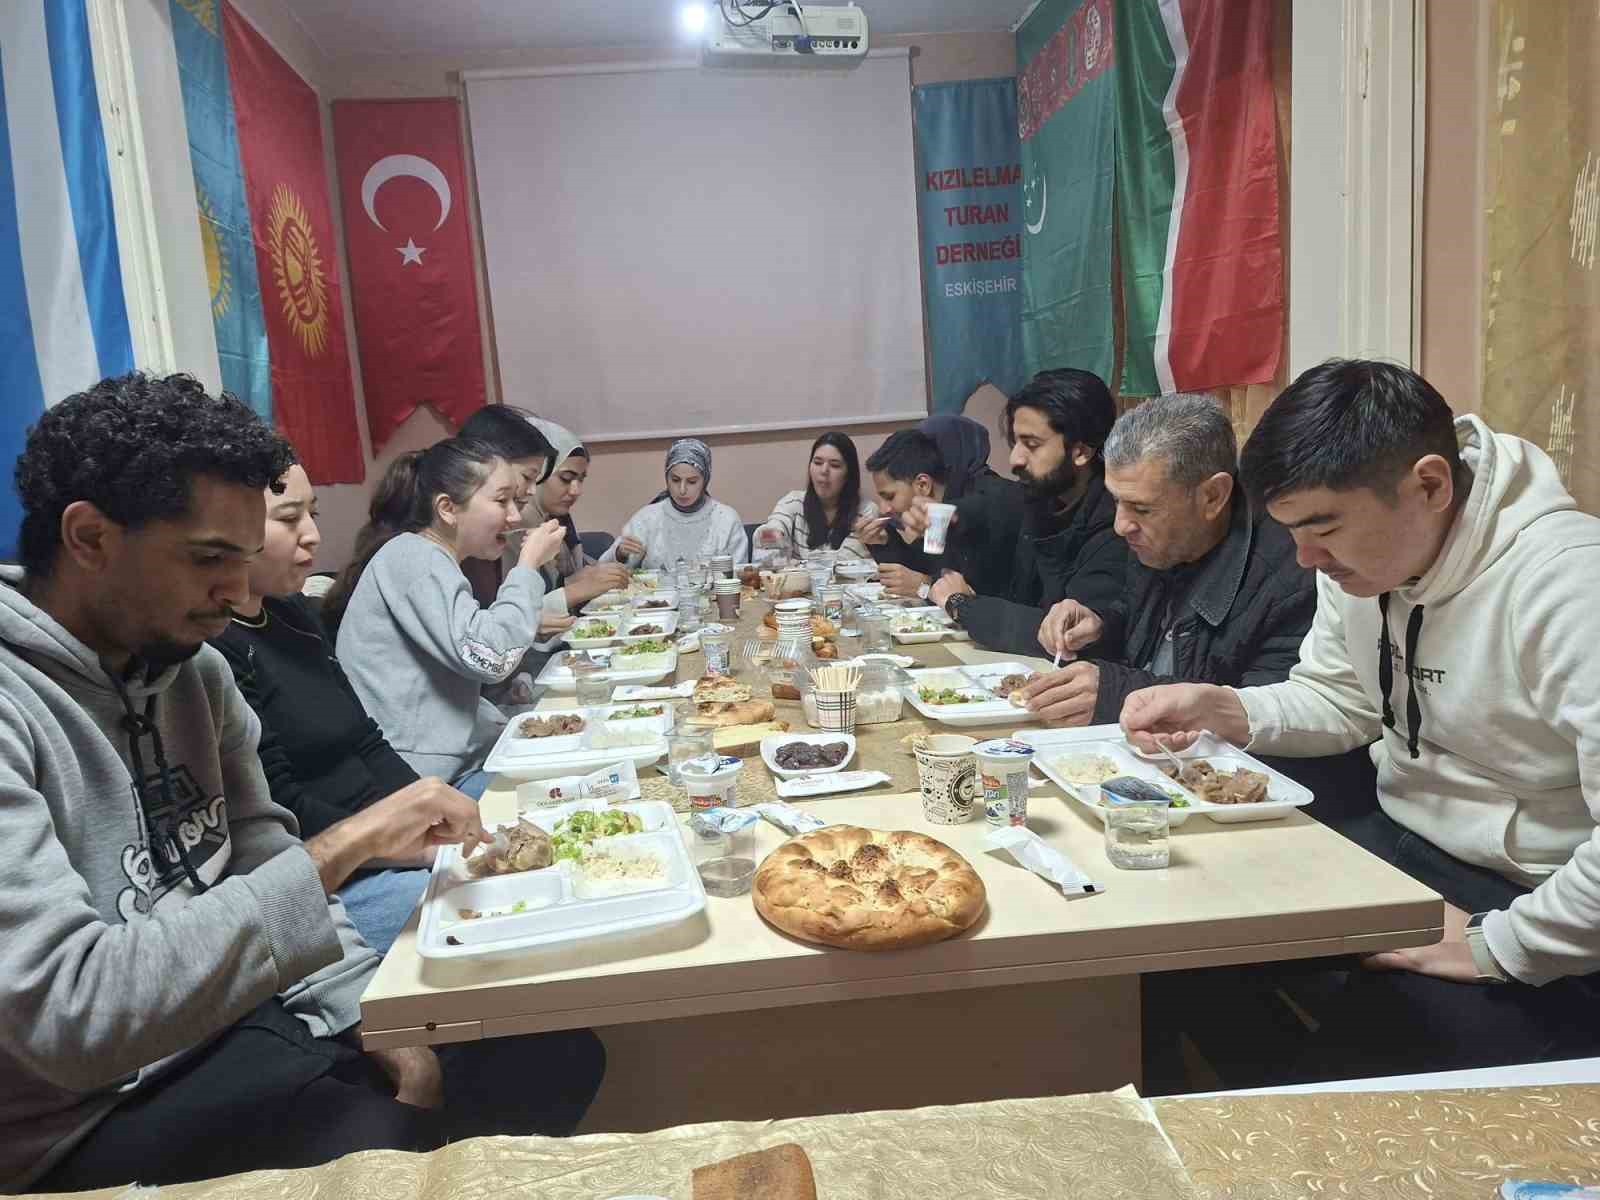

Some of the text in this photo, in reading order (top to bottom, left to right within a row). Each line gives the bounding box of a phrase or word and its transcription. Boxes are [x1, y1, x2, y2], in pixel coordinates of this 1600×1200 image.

[927, 164, 1022, 191] KIZILELMA
[944, 203, 1008, 226] TURAN
[936, 233, 1021, 265] DERNEĞİ
[944, 275, 1016, 297] ESKİŞEHİR
